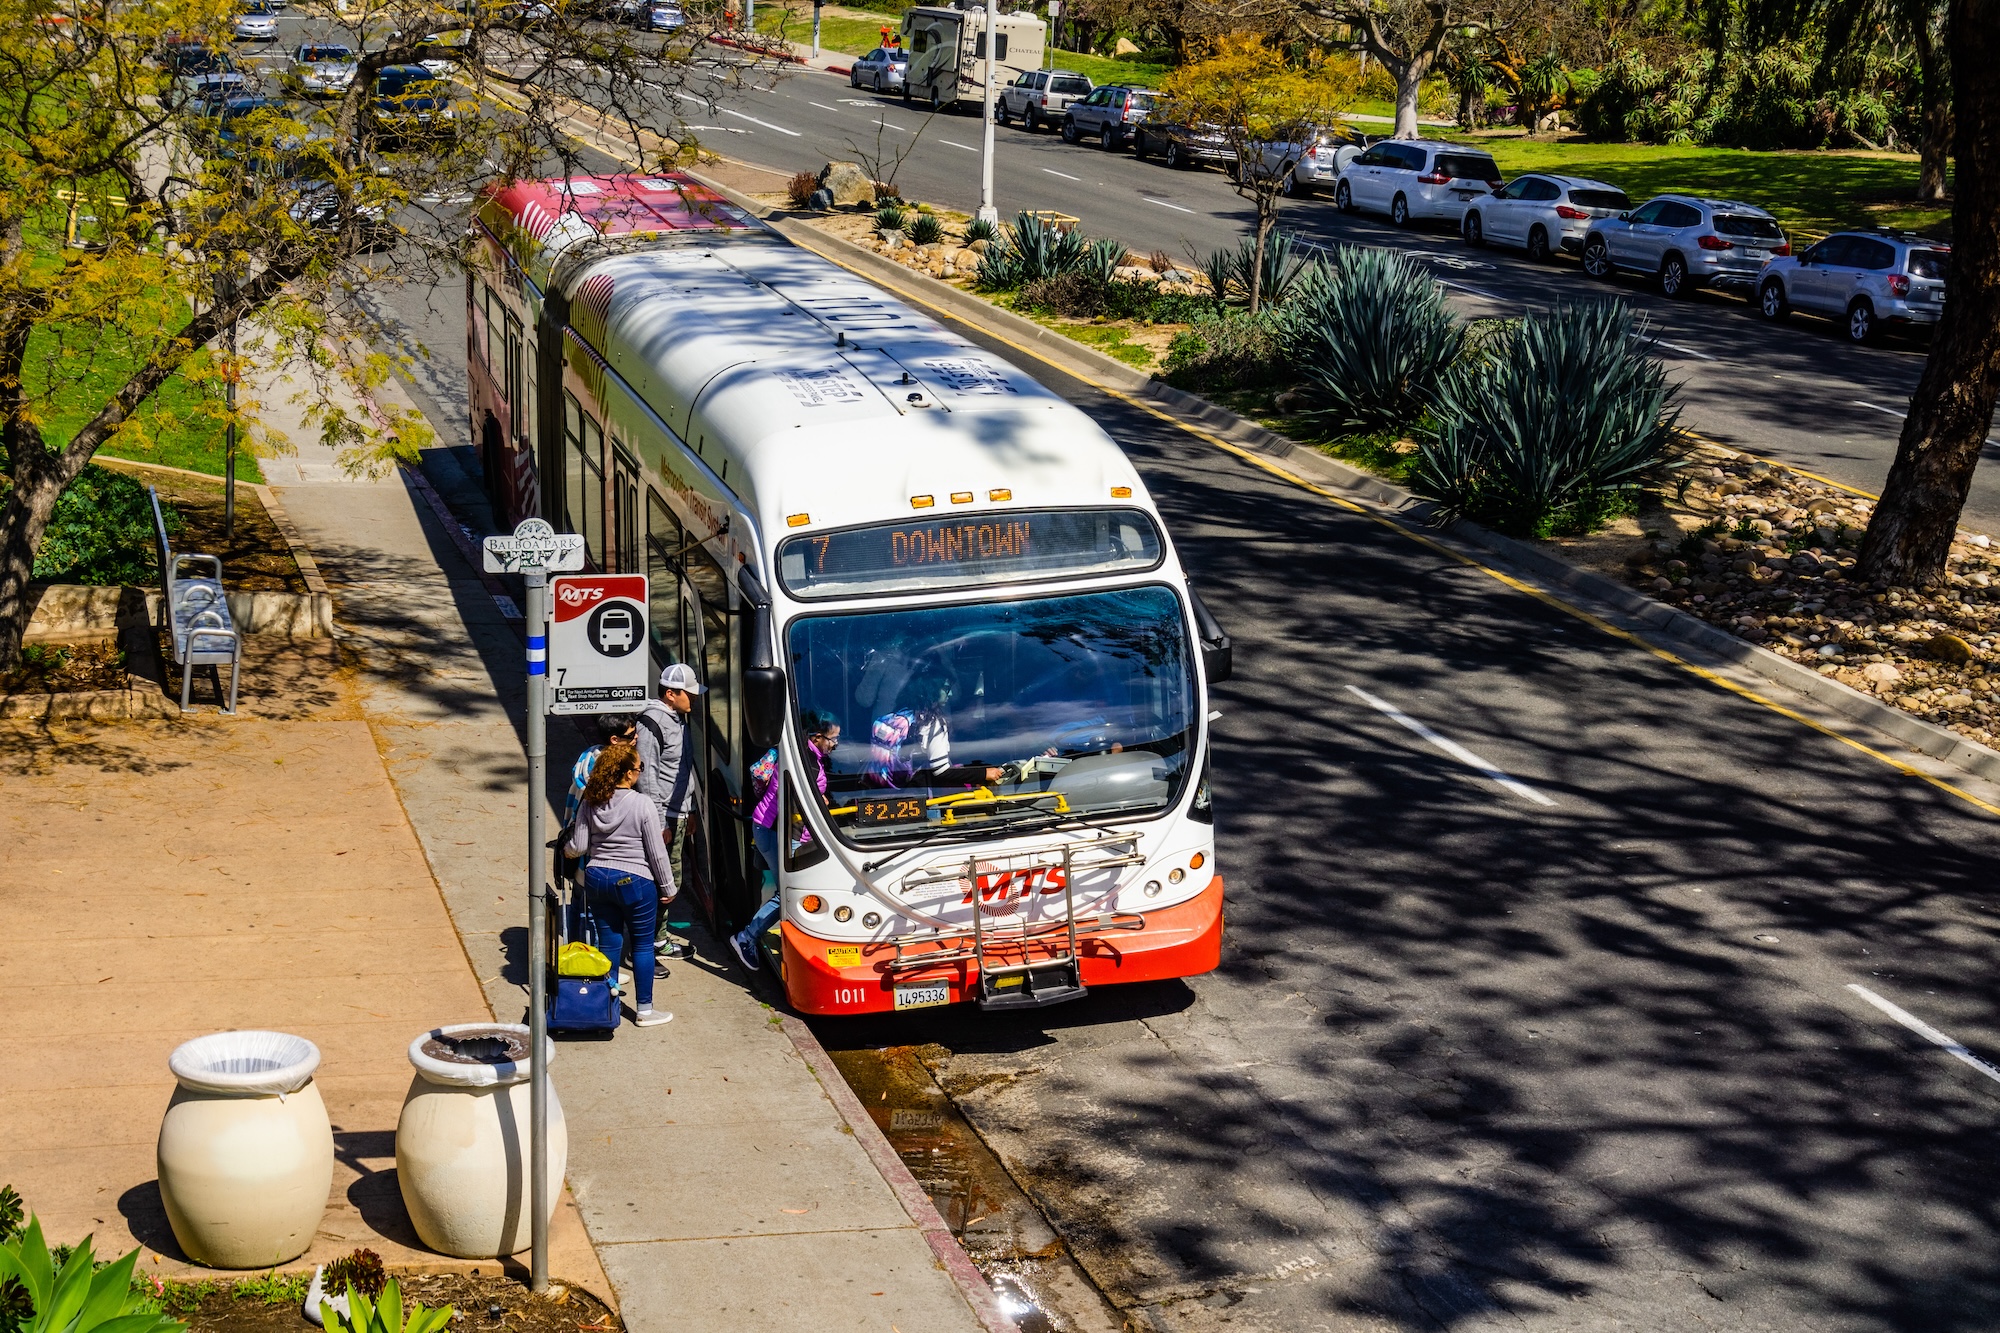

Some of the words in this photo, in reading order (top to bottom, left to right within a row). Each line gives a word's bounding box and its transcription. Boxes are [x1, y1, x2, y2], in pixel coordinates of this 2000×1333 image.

[938, 362, 974, 378] STEP
[813, 379, 848, 398] STEP
[957, 378, 987, 390] NO
[660, 454, 689, 505] Metropolitan
[689, 486, 707, 525] Transit
[489, 538, 540, 550] BALBOA
[544, 538, 578, 549] PARK
[812, 536, 831, 574] 7
[892, 520, 1031, 565] DOWNTOWN
[559, 587, 604, 601] MTS
[557, 668, 567, 686] 7
[574, 703, 599, 711] 12067
[865, 800, 922, 821] $2.25
[961, 867, 1066, 905] MTS
[834, 987, 865, 1004] 1011
[898, 987, 945, 1007] 1495336
